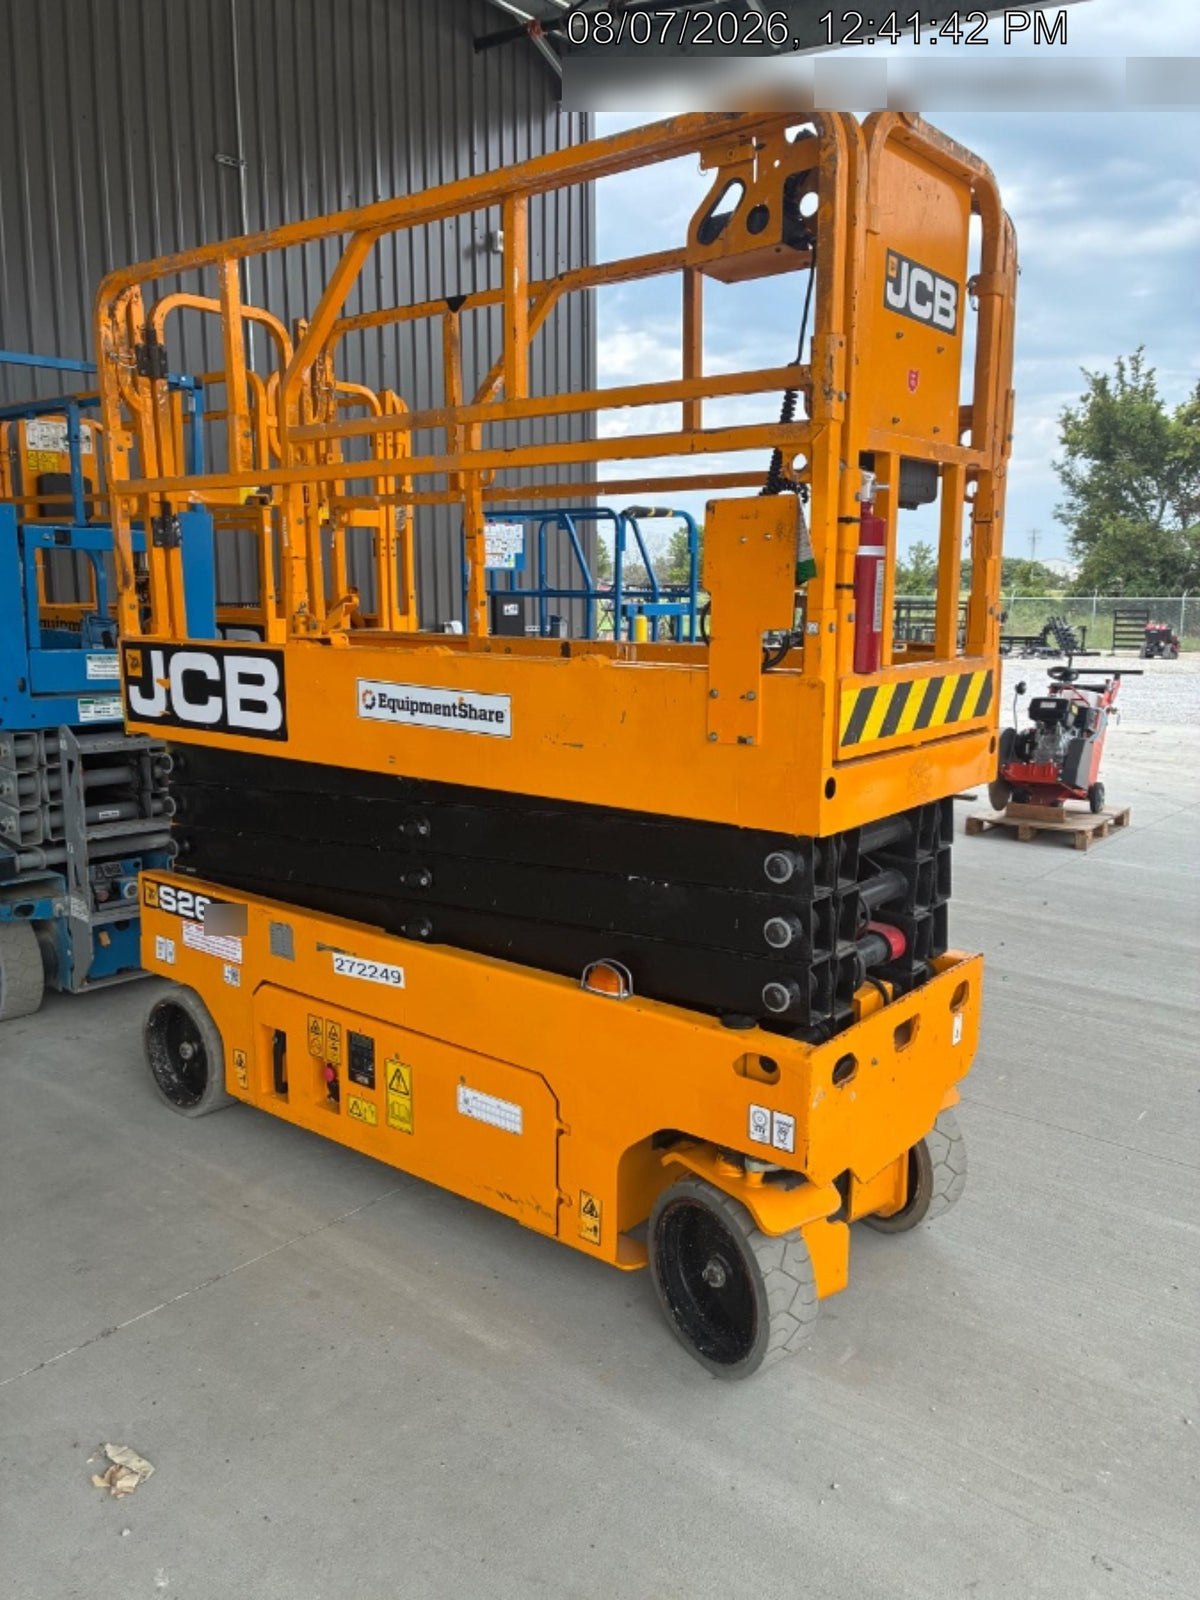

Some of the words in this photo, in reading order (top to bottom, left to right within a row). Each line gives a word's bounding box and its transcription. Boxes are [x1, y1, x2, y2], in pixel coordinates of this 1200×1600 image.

[886, 261, 957, 330] JCB
[128, 650, 283, 732] JCB
[378, 693, 505, 723] EquipmentShare
[335, 957, 402, 984] 272249
